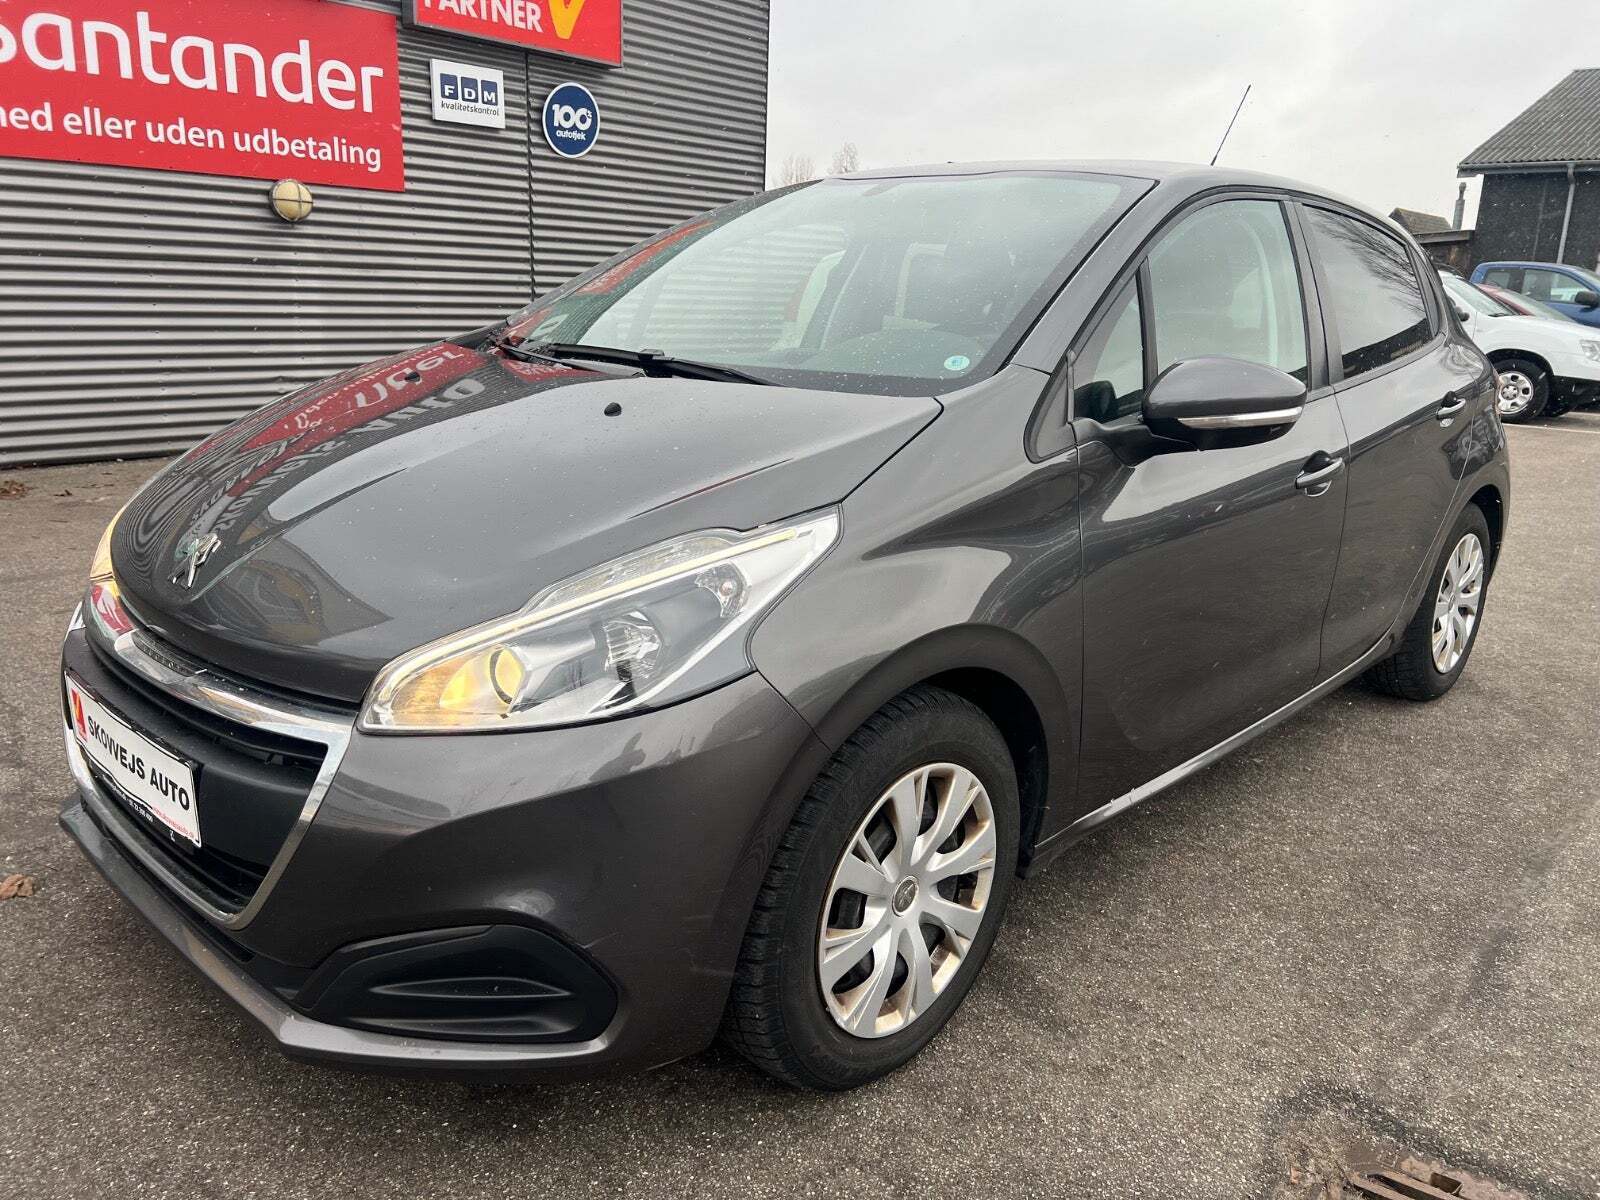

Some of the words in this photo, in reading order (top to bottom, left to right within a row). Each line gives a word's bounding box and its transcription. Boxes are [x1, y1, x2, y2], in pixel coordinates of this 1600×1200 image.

[424, 0, 544, 33] RTNER
[441, 101, 500, 116] kvalitetskontrol
[0, 101, 54, 132] ed
[63, 106, 137, 140] eller
[145, 117, 226, 149] uden
[233, 128, 382, 172] udbetaling
[556, 130, 586, 141] autotjek
[87, 715, 146, 782] SKOVVEJS
[149, 767, 190, 812] AUTO
